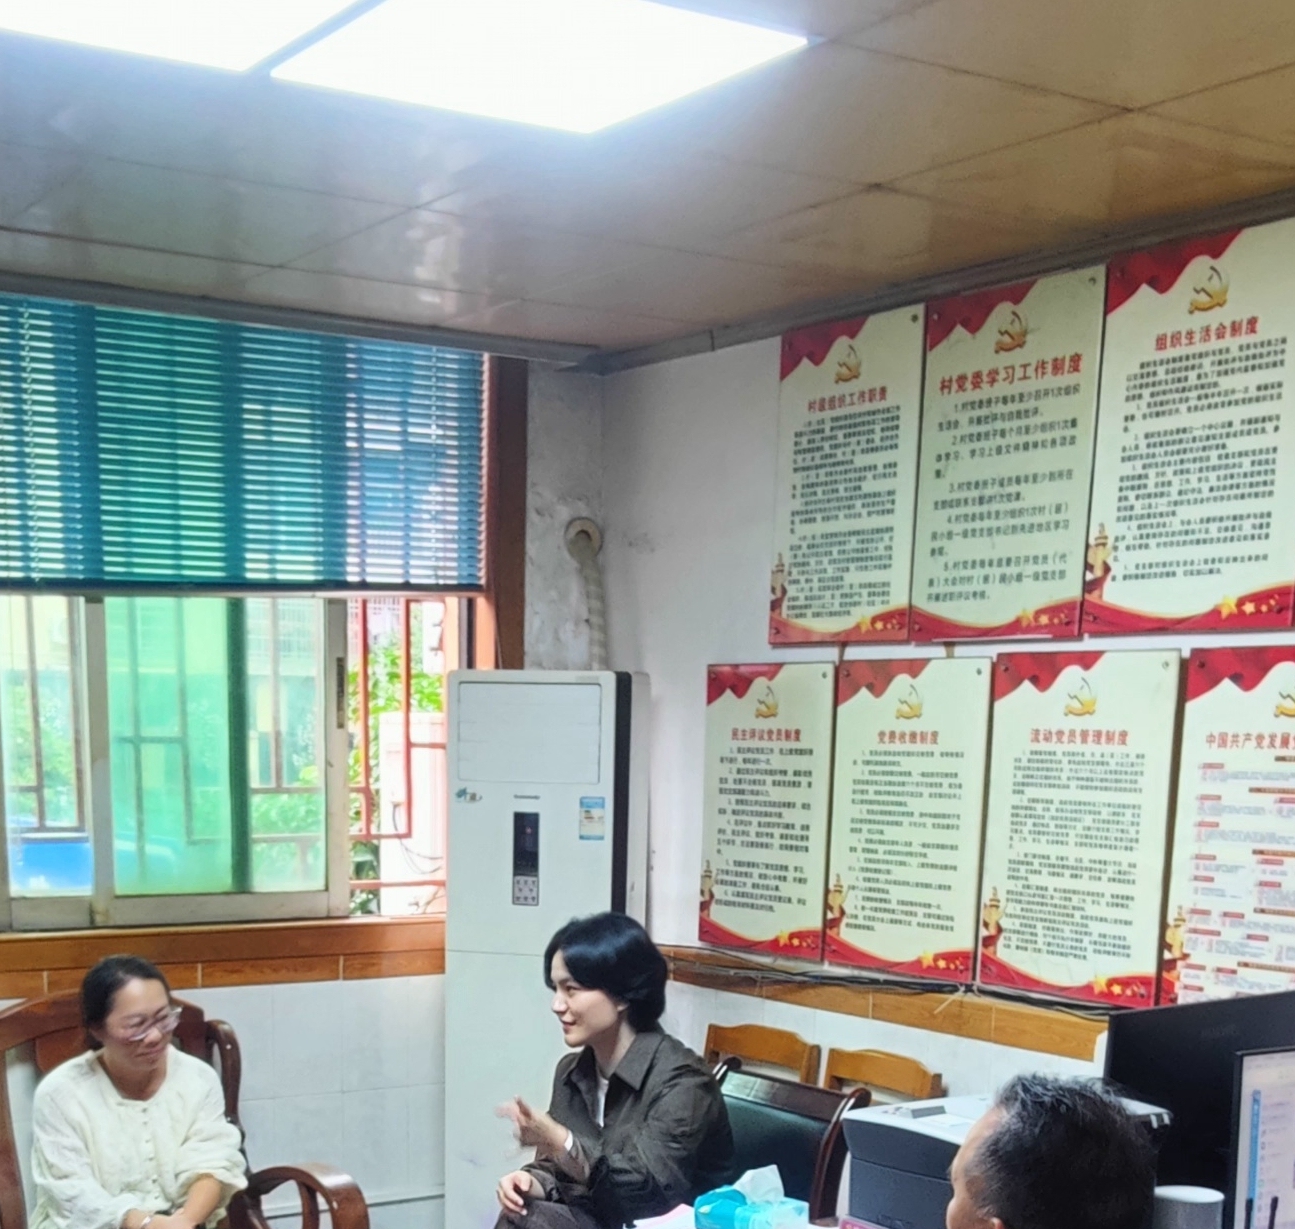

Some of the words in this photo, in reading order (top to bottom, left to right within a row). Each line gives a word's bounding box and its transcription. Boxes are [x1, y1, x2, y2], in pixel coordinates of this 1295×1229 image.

[1155, 316, 1259, 351] 组织生活会制度
[938, 352, 1082, 396] 村党委学习工作制度
[1030, 728, 1129, 746] 流动党员管理制度
